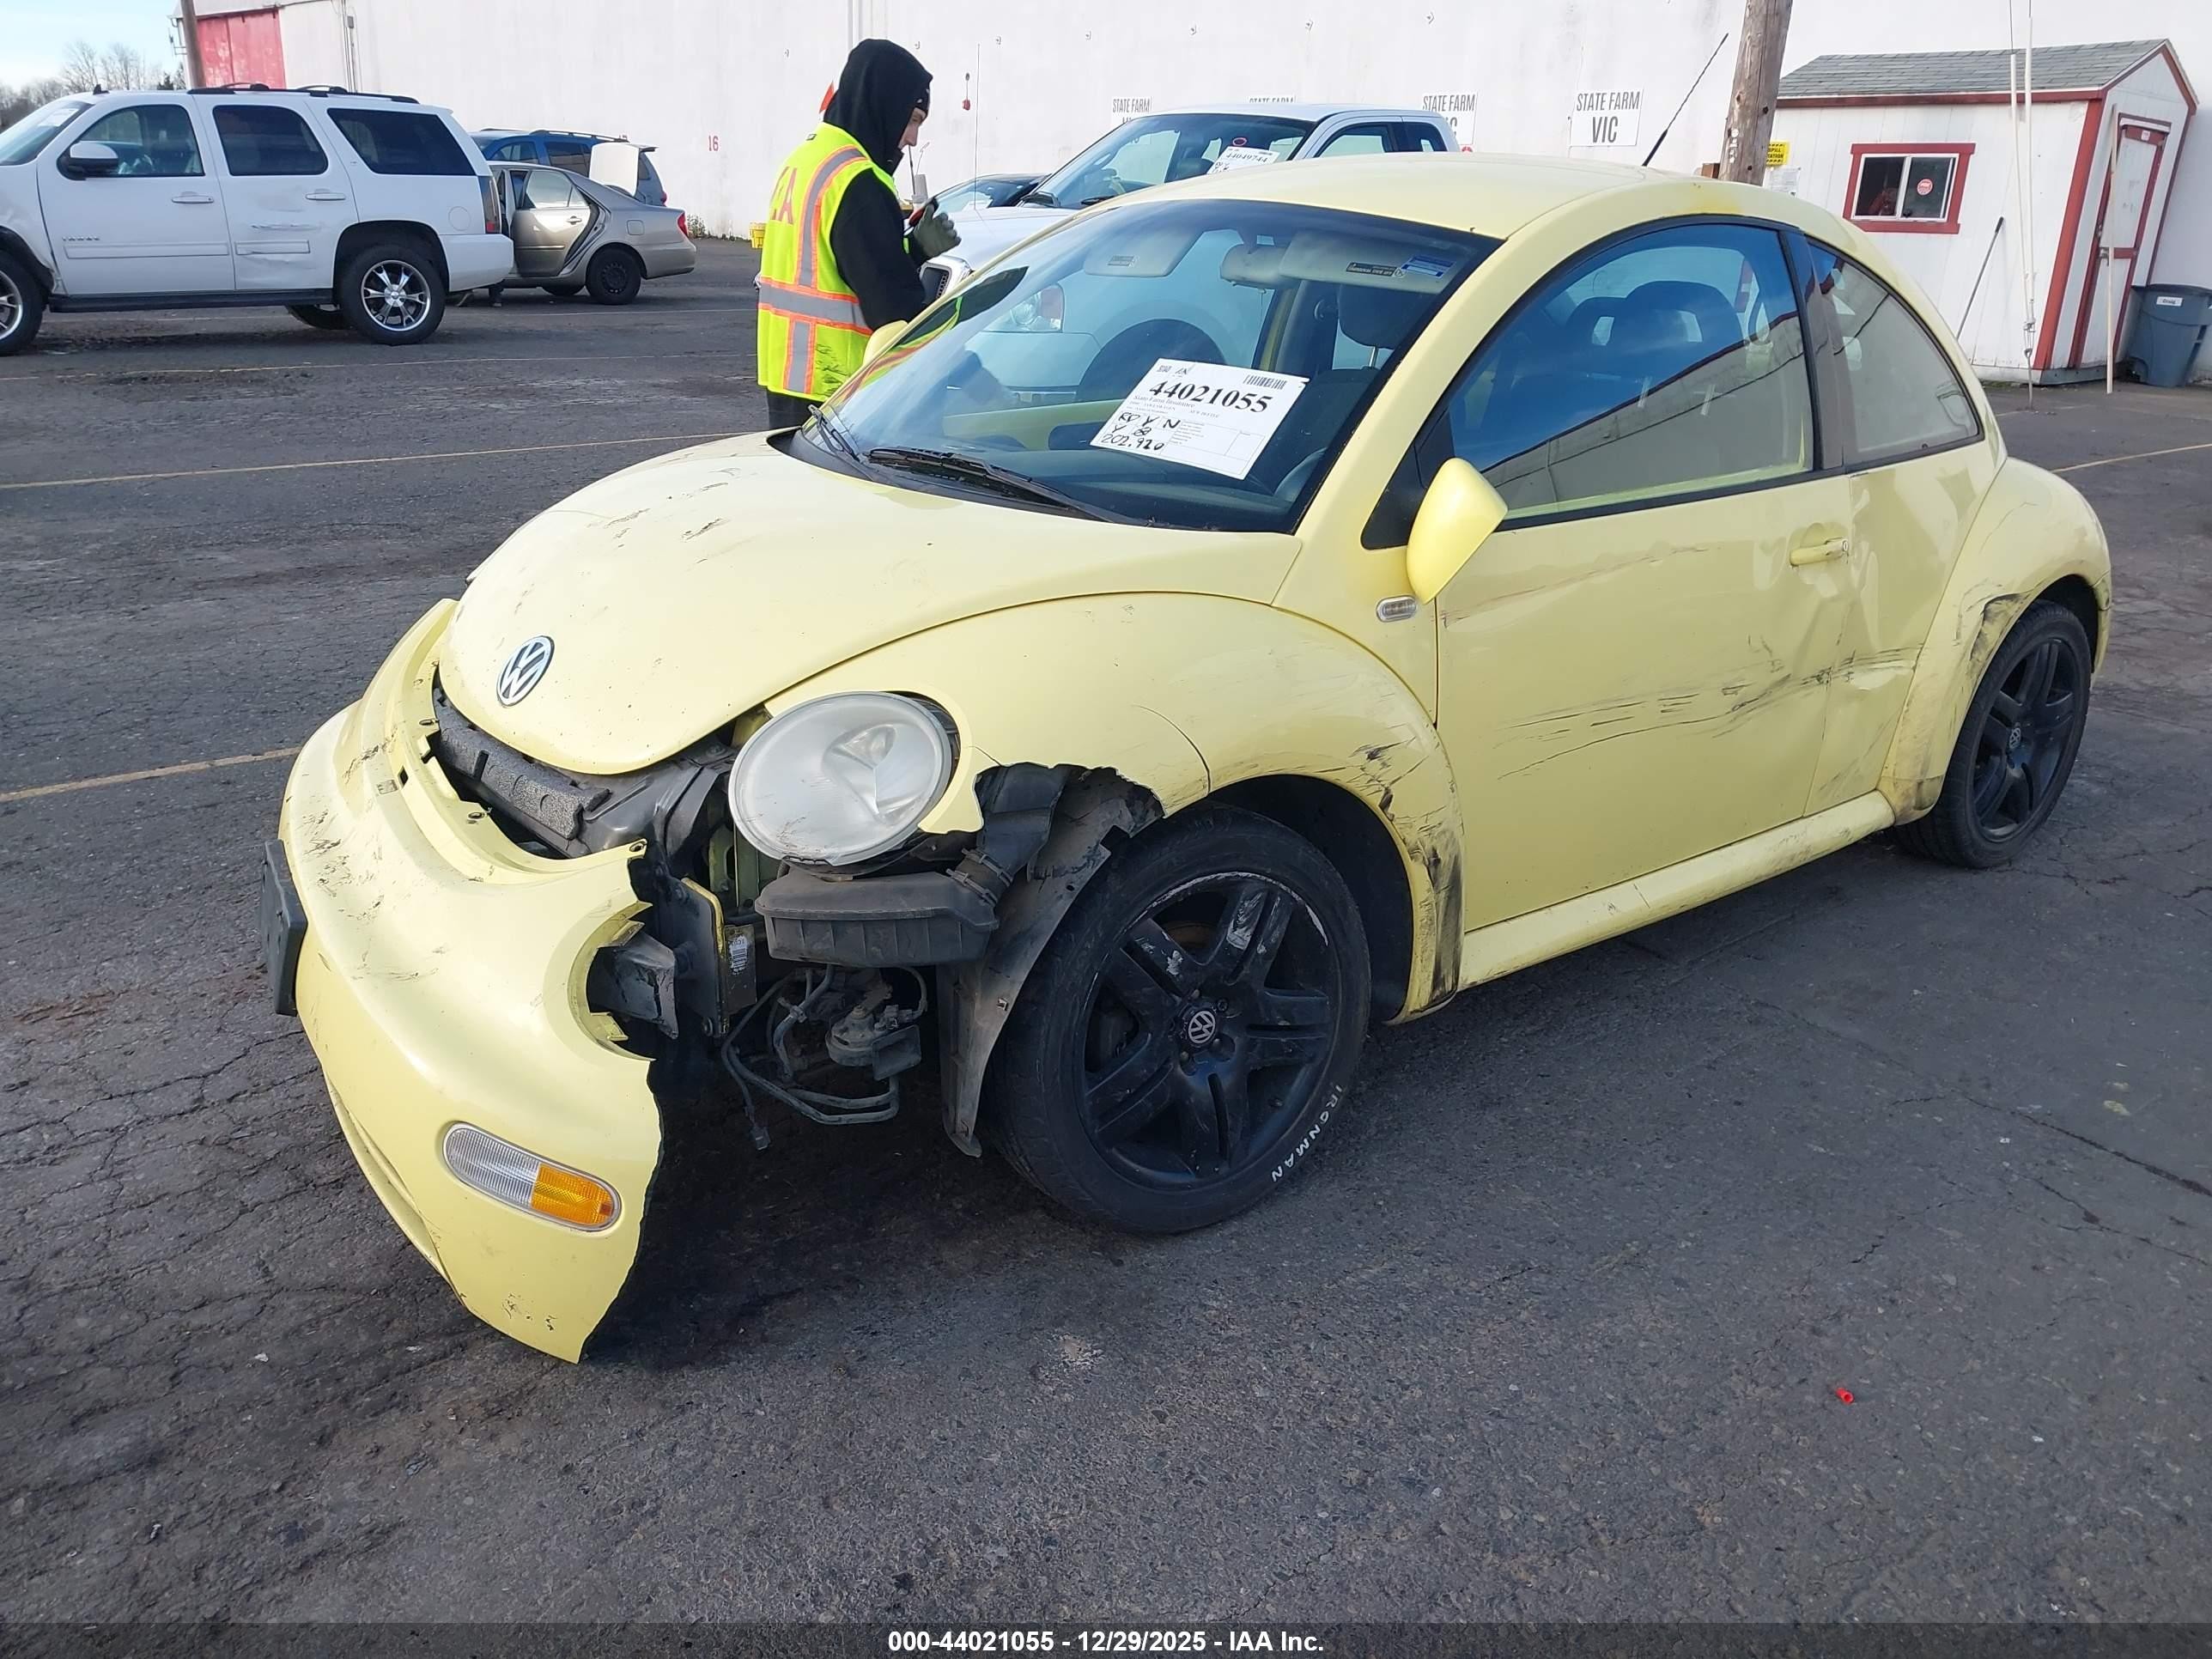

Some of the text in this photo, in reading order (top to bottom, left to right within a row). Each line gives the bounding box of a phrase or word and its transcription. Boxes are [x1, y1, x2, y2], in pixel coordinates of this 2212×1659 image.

[1113, 98, 1151, 112] STATE FARM
[1423, 94, 1475, 112] STATE FARM
[1577, 91, 1640, 111] STATE FARM
[1592, 116, 1618, 143] VIC
[708, 136, 719, 151] 16
[1149, 380, 1273, 412] 44021055
[1271, 1085, 1343, 1182] IRONMAN
